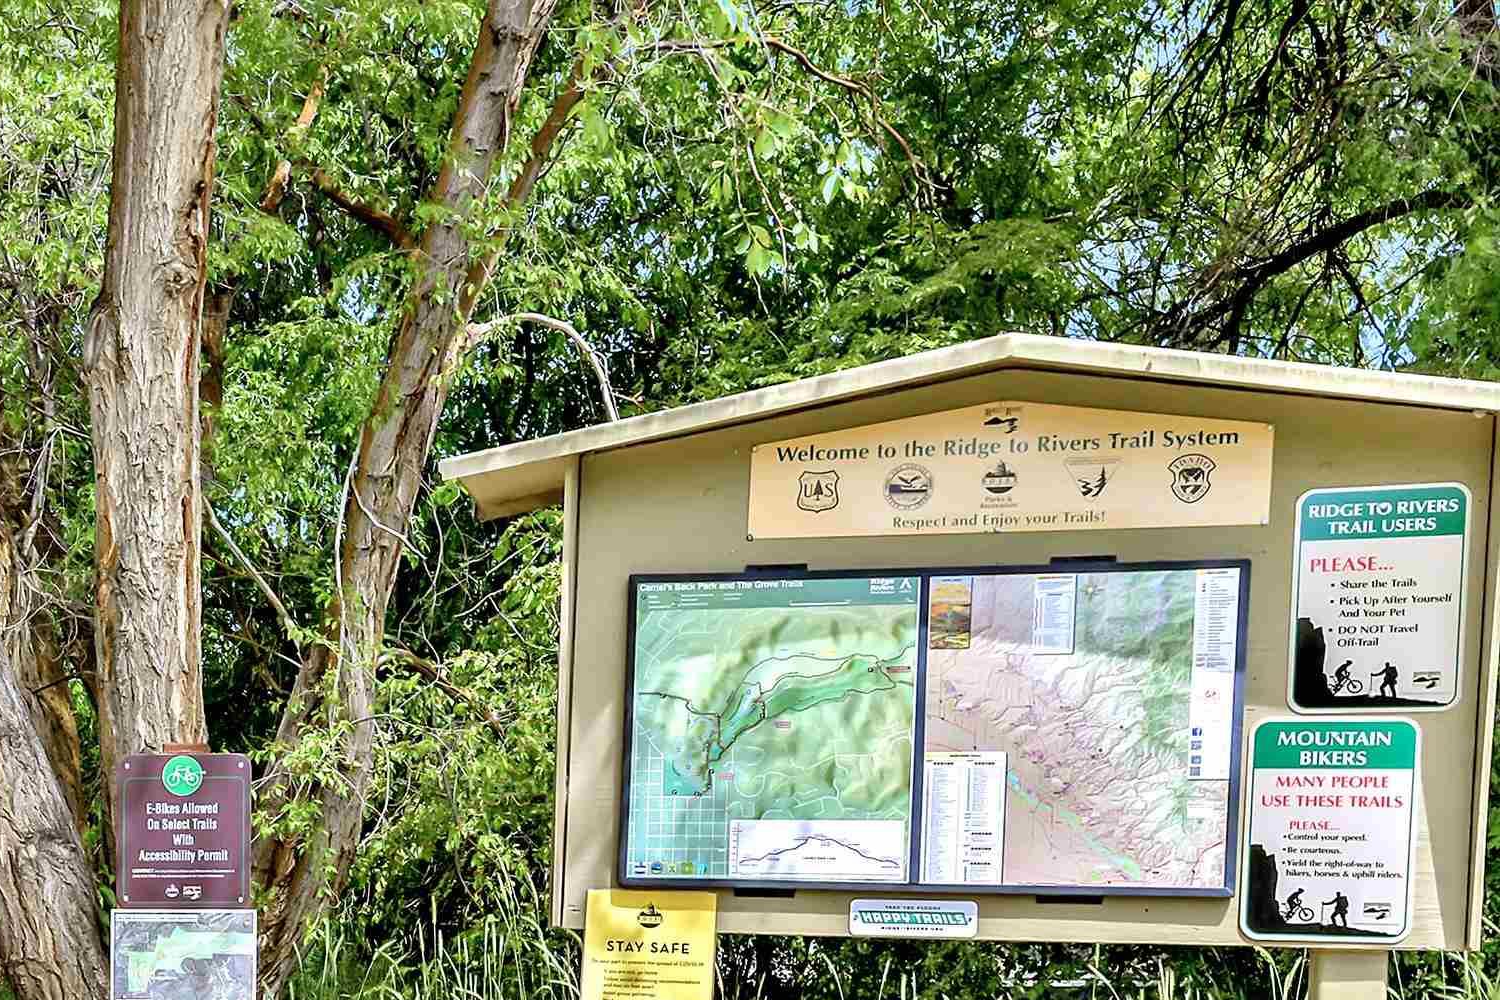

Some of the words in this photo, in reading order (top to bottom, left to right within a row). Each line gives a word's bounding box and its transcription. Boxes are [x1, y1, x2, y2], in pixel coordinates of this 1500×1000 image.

[777, 445, 869, 462] Welcome
[878, 445, 896, 459] to
[905, 441, 936, 457] the
[944, 438, 1001, 458] Ridge
[1010, 439, 1029, 454] to
[1037, 435, 1101, 453] Rivers
[1108, 431, 1154, 449] Trail
[1163, 430, 1240, 450] System
[1308, 504, 1363, 518] RIDGE
[1367, 502, 1392, 516] TO
[1397, 499, 1460, 514] RIVERS
[893, 514, 946, 530] Respect
[957, 512, 977, 527] and
[982, 511, 1021, 528] Enjoy
[1025, 514, 1058, 528] your
[1062, 510, 1106, 524] Trails!
[1328, 521, 1377, 536] TRAIL
[1382, 518, 1437, 533] USERS
[1310, 556, 1394, 573] PLEASE...
[1340, 581, 1368, 589] Share
[1372, 579, 1388, 588] the
[1392, 578, 1417, 588] Trails
[1339, 596, 1360, 606] Pick
[1364, 596, 1379, 607] Up
[1382, 595, 1407, 604] After
[1411, 593, 1452, 603] Yourself
[1338, 609, 1359, 618] And
[1363, 609, 1386, 618] Your
[1389, 608, 1406, 617] Pet
[1338, 625, 1357, 635] DO
[1360, 625, 1384, 634] NOT
[1387, 623, 1418, 633] Travel
[1337, 637, 1379, 647] Off-Trail
[1277, 731, 1392, 746] MOUNTAIN
[1300, 750, 1367, 766] BIKERS
[1276, 776, 1326, 788] MANY
[1331, 776, 1389, 788] PEOPLE
[1261, 795, 1291, 807] USE
[1295, 795, 1343, 807] THESE
[1349, 796, 1404, 808] TRAILS
[146, 803, 180, 814] E-Bikes
[182, 803, 218, 814] Allowed
[147, 819, 160, 830] On
[162, 819, 190, 830] Select
[192, 819, 217, 830] Trails
[172, 834, 193, 846] With
[1287, 833, 1318, 841] Control
[1341, 833, 1367, 842] speed.
[139, 850, 195, 864] Accessibility
[197, 850, 228, 862] Permit
[1287, 859, 1307, 867] Yield
[1324, 860, 1372, 869] right-of-way
[1314, 870, 1340, 878] horses
[1352, 870, 1375, 879] uphill
[861, 912, 911, 924] HAPPY
[915, 913, 966, 925] TRAILS
[607, 940, 644, 952] STAY
[650, 942, 690, 954] SAFE
